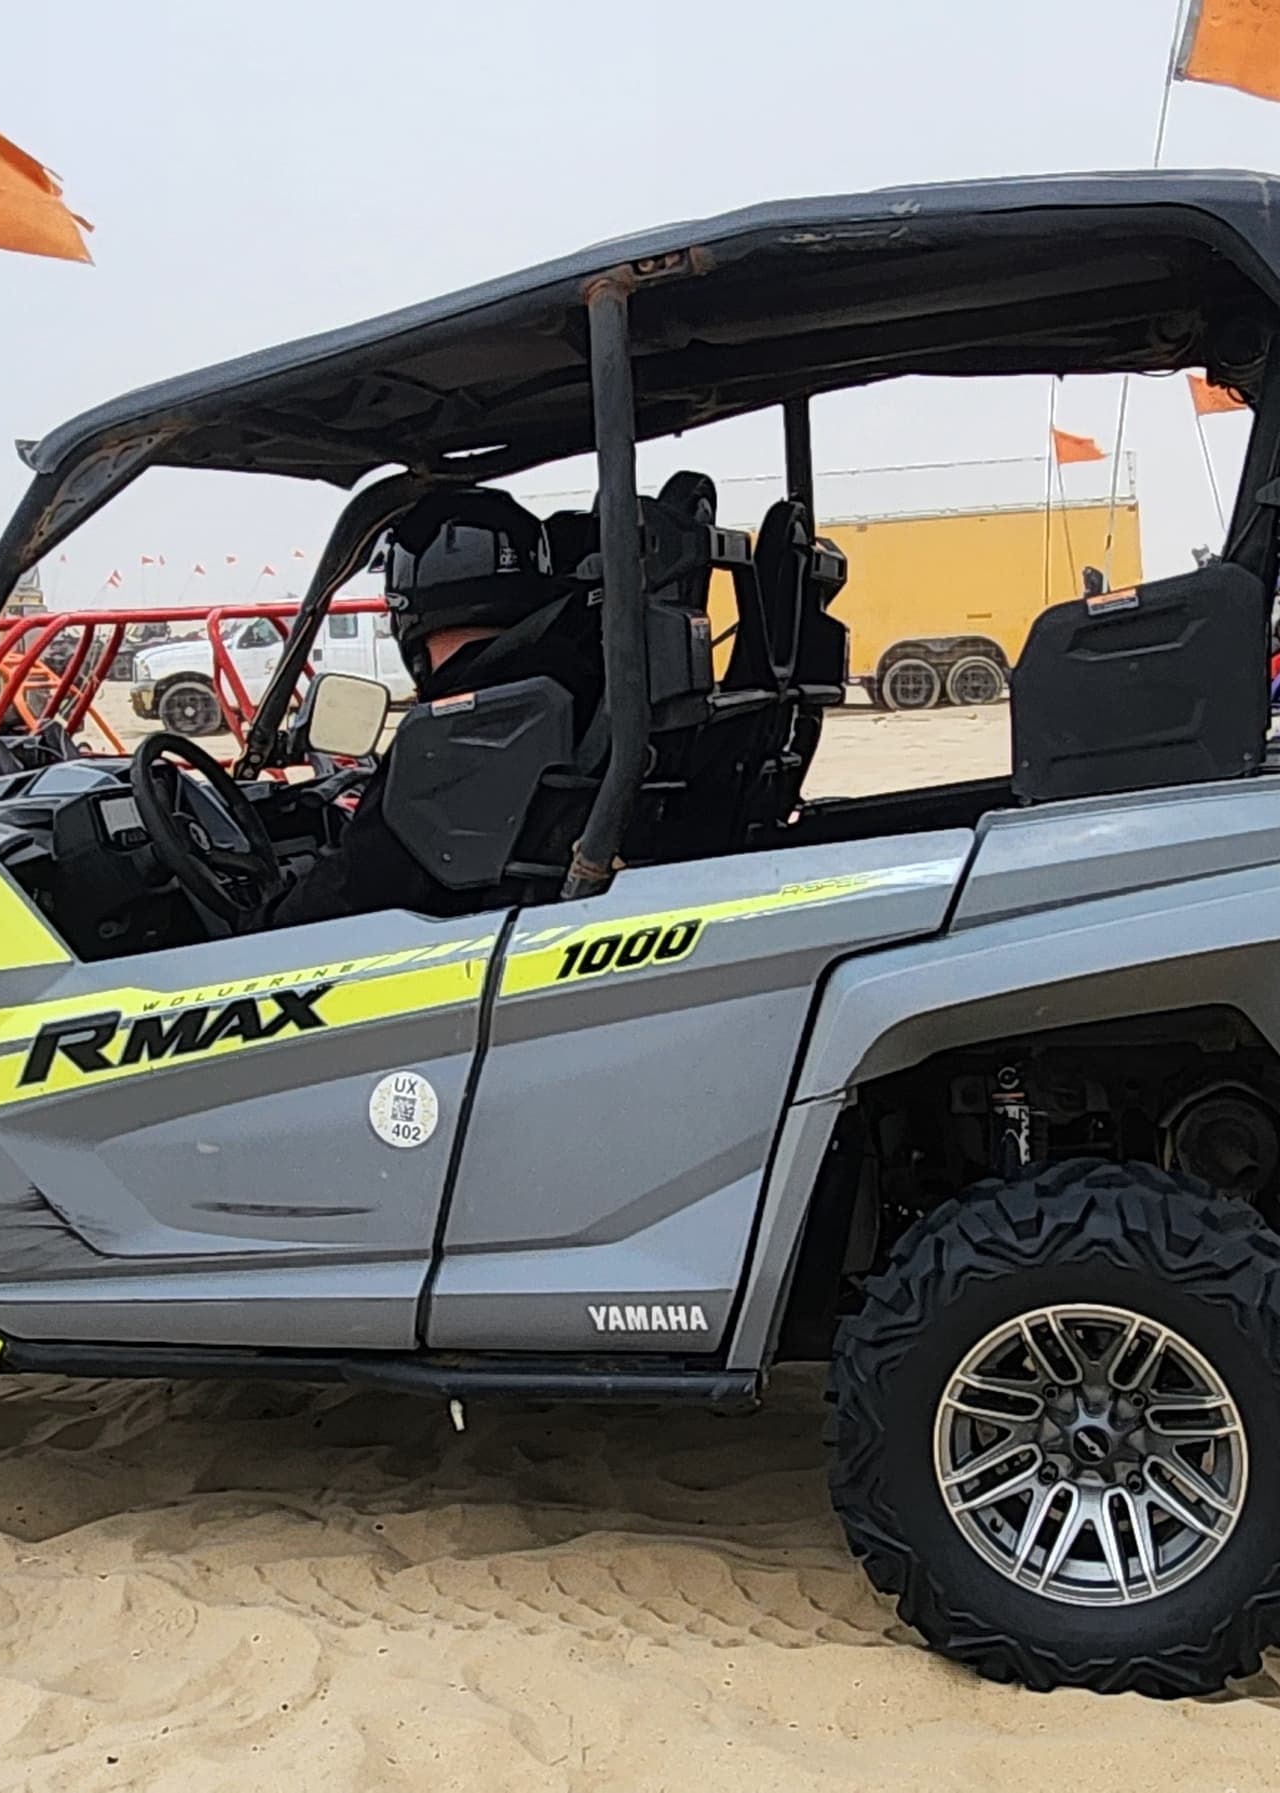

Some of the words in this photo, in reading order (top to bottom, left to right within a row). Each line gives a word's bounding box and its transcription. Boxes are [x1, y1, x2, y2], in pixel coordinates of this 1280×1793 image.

[556, 919, 703, 980] 1000
[16, 980, 338, 1088] RMAX
[394, 1077, 418, 1096] UX
[391, 1123, 422, 1142] 402
[587, 1305, 710, 1331] YAMAHA
